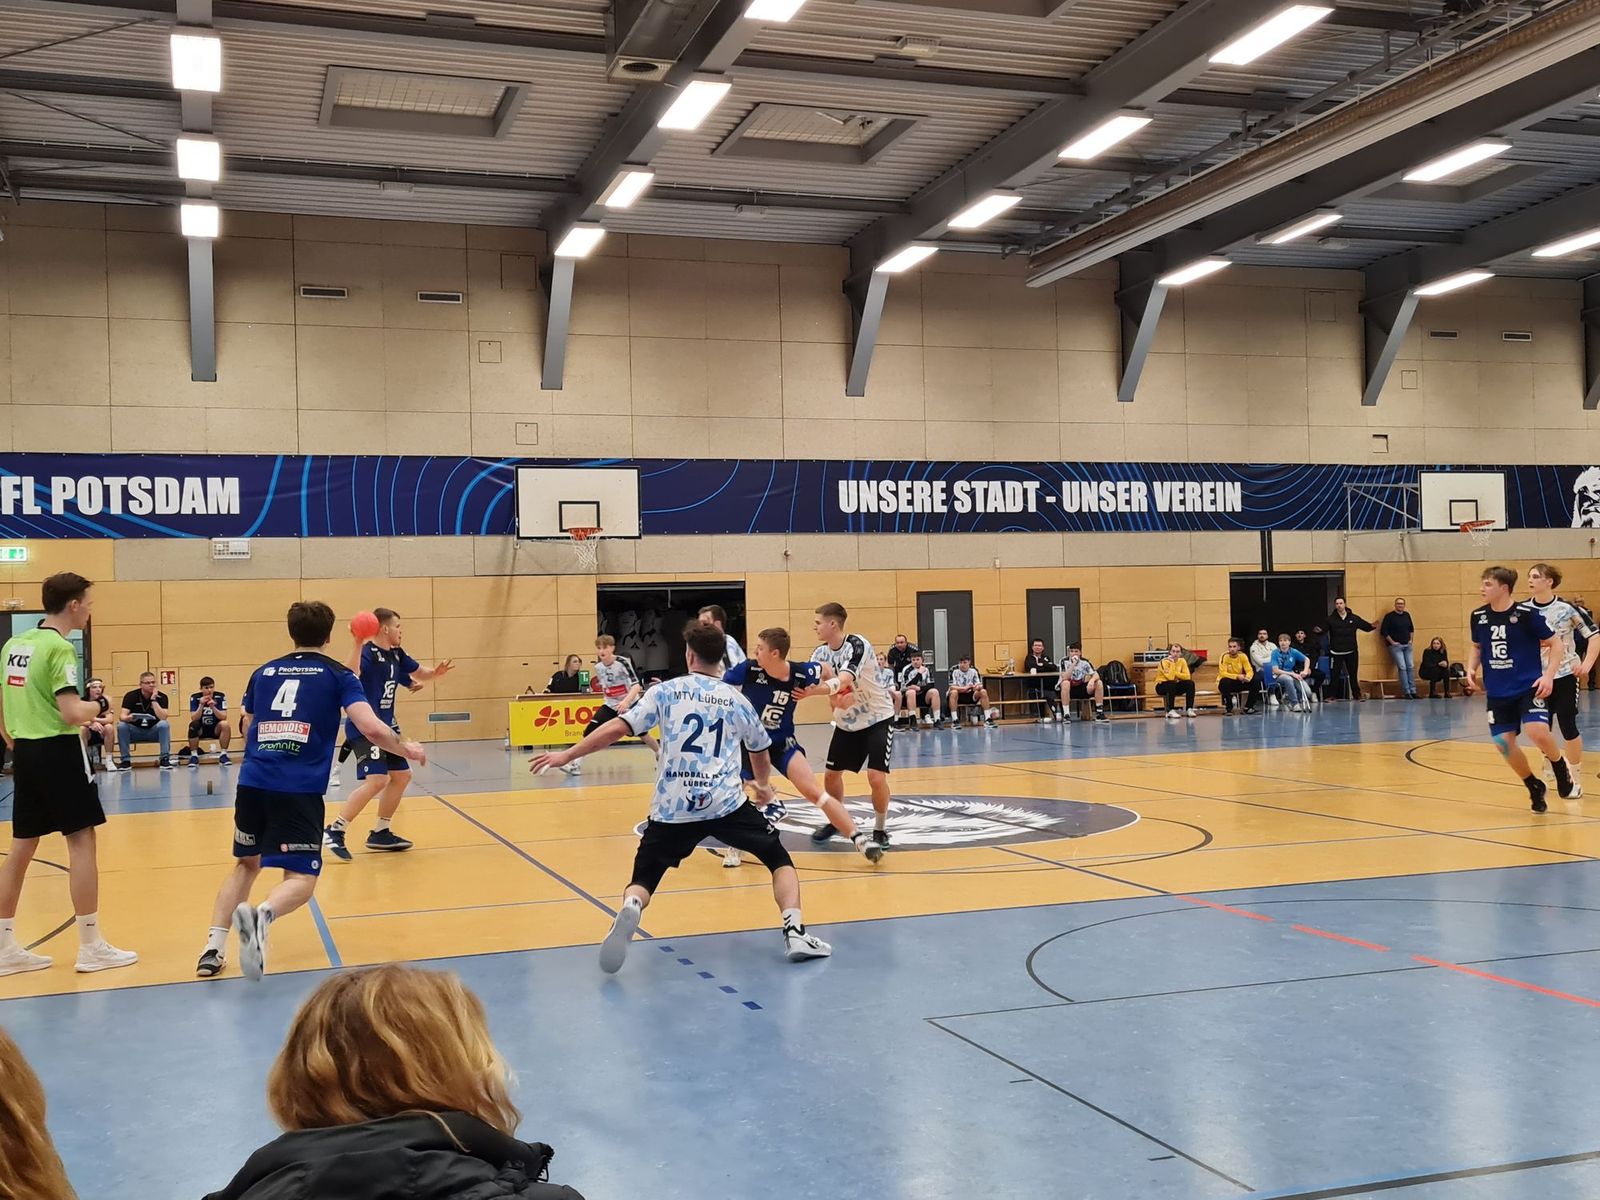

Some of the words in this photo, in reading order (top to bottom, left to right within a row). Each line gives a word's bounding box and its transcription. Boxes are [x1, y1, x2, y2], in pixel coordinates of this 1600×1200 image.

[51, 476, 240, 515] POTSDAM
[838, 480, 948, 513] UNSERE
[954, 480, 1040, 513] STADT
[1062, 481, 1148, 513] UNSER
[1153, 481, 1242, 513] VEREIN
[1490, 625, 1506, 640] 24
[271, 679, 300, 717] 4
[673, 691, 696, 701] MTV
[698, 693, 734, 708] Lübeck
[772, 690, 790, 705] 15
[259, 723, 304, 734] REMONDIS
[680, 712, 724, 758] 21
[257, 741, 301, 752] promnitz
[665, 771, 710, 780] HANDBALL
